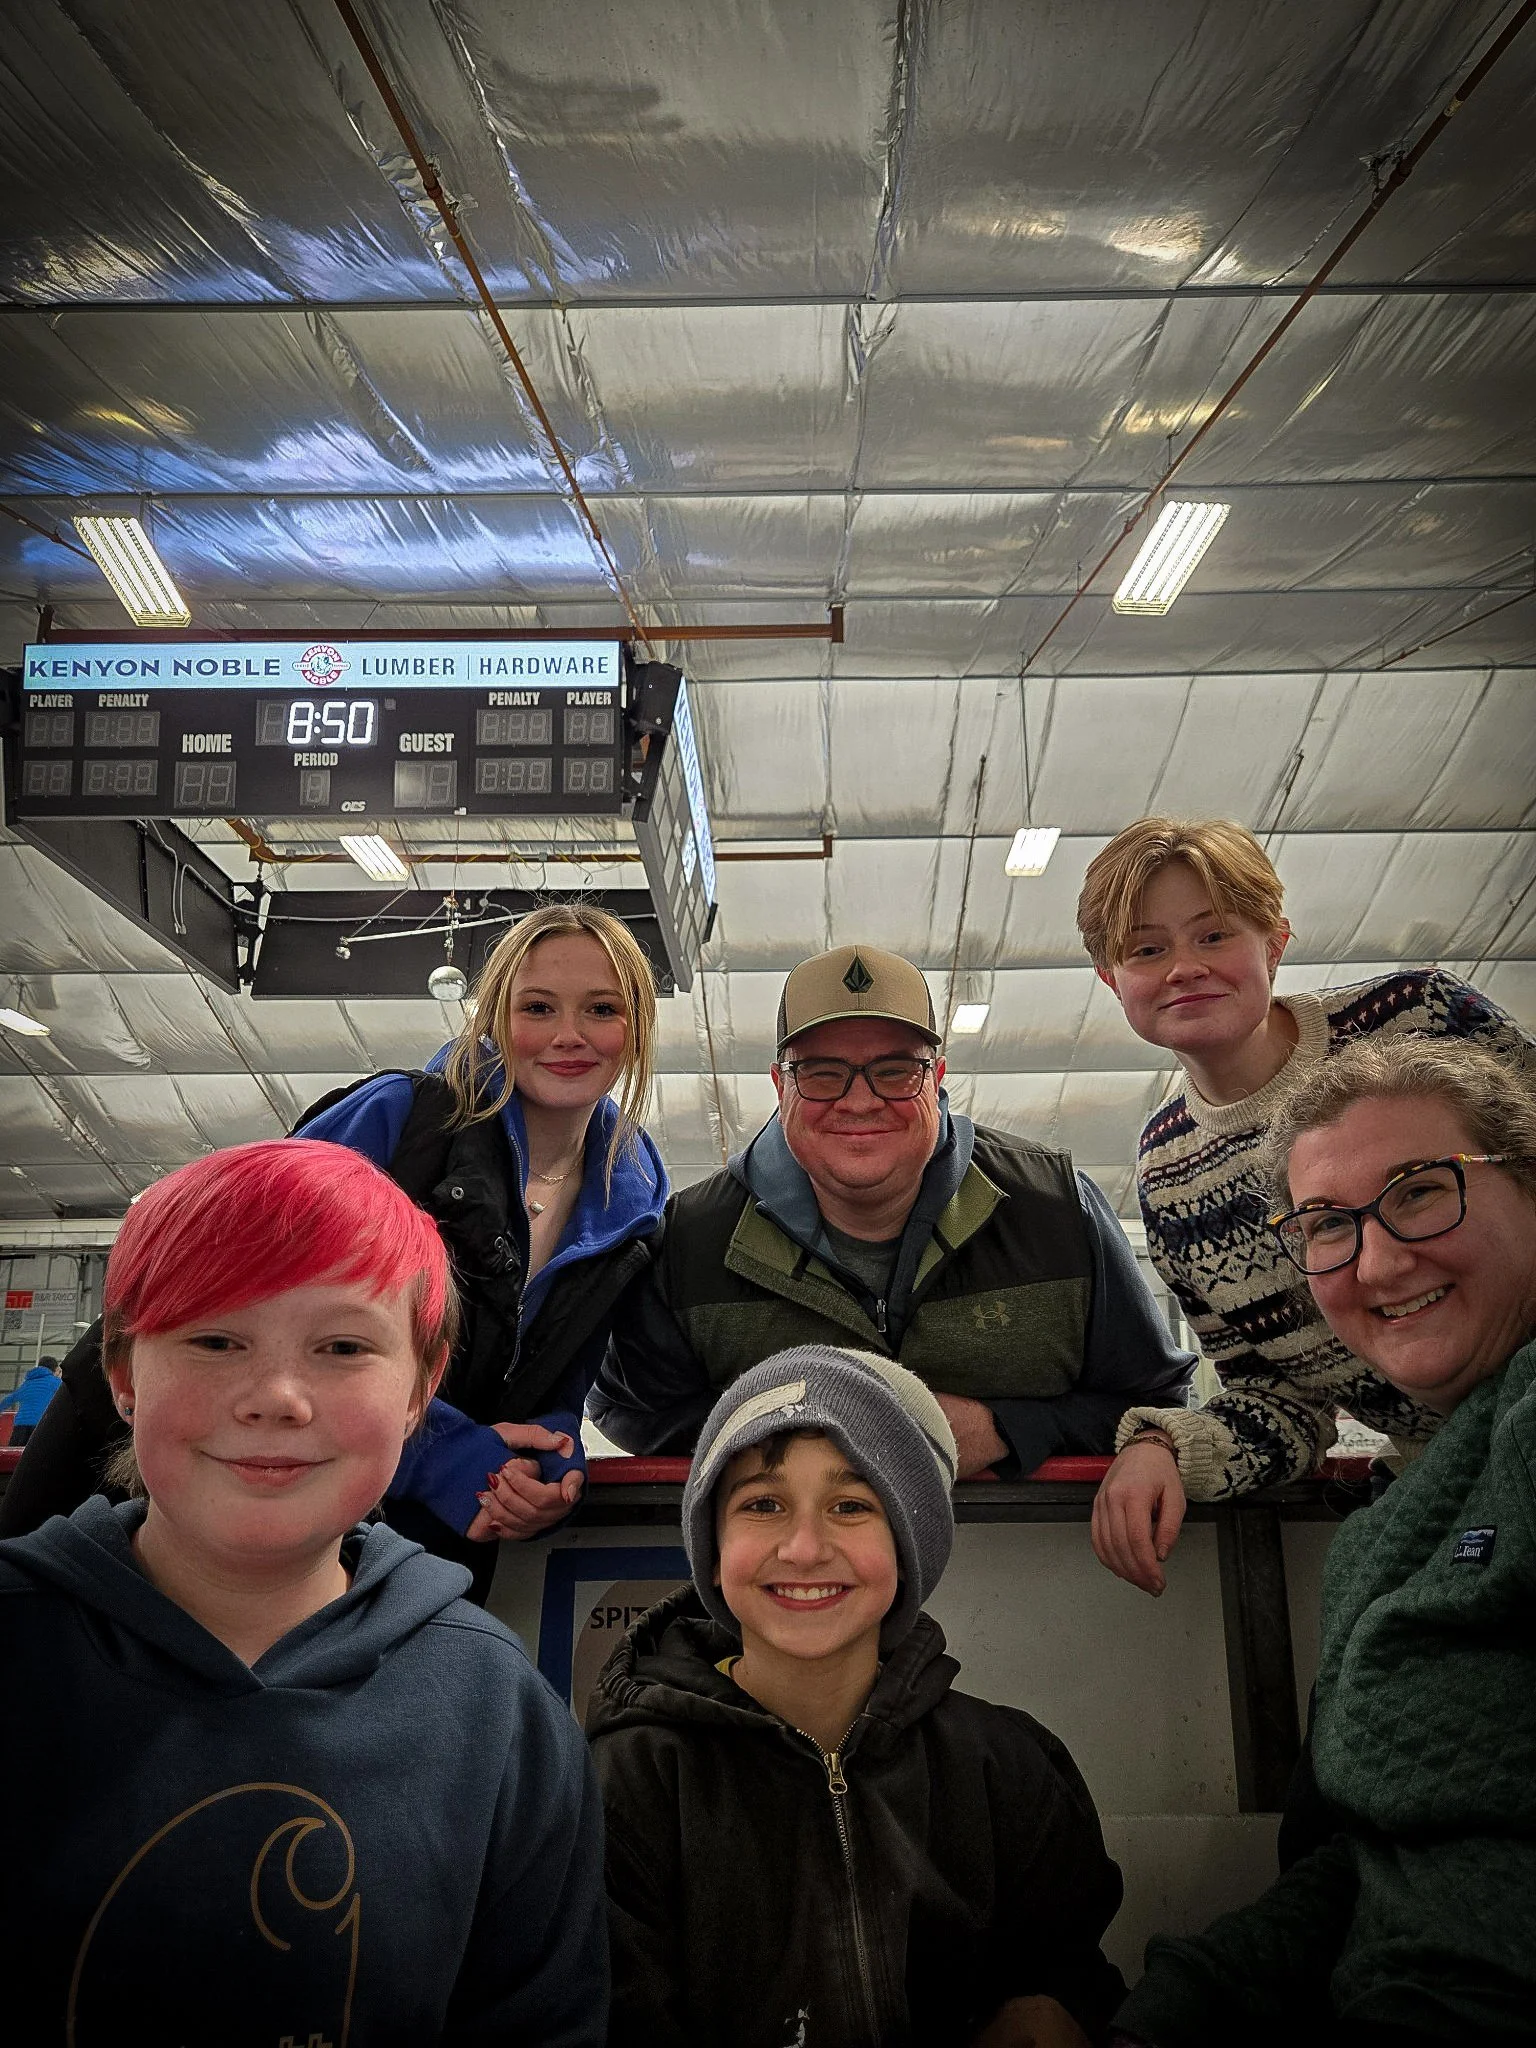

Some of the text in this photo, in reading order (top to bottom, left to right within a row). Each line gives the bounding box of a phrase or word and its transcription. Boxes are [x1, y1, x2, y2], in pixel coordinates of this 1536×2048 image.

[29, 658, 281, 678] KENYON NOBLE
[362, 658, 455, 676] LUMBER
[479, 656, 609, 675] HARDWARE
[29, 693, 74, 708] PLAYER
[98, 693, 150, 708] PENALTY
[488, 691, 541, 706] PENALTY
[566, 691, 612, 706] PLAYER
[286, 701, 375, 745] 8:50
[181, 733, 232, 753] HOME
[399, 733, 455, 753] GUEST
[293, 752, 339, 767] PERIOD
